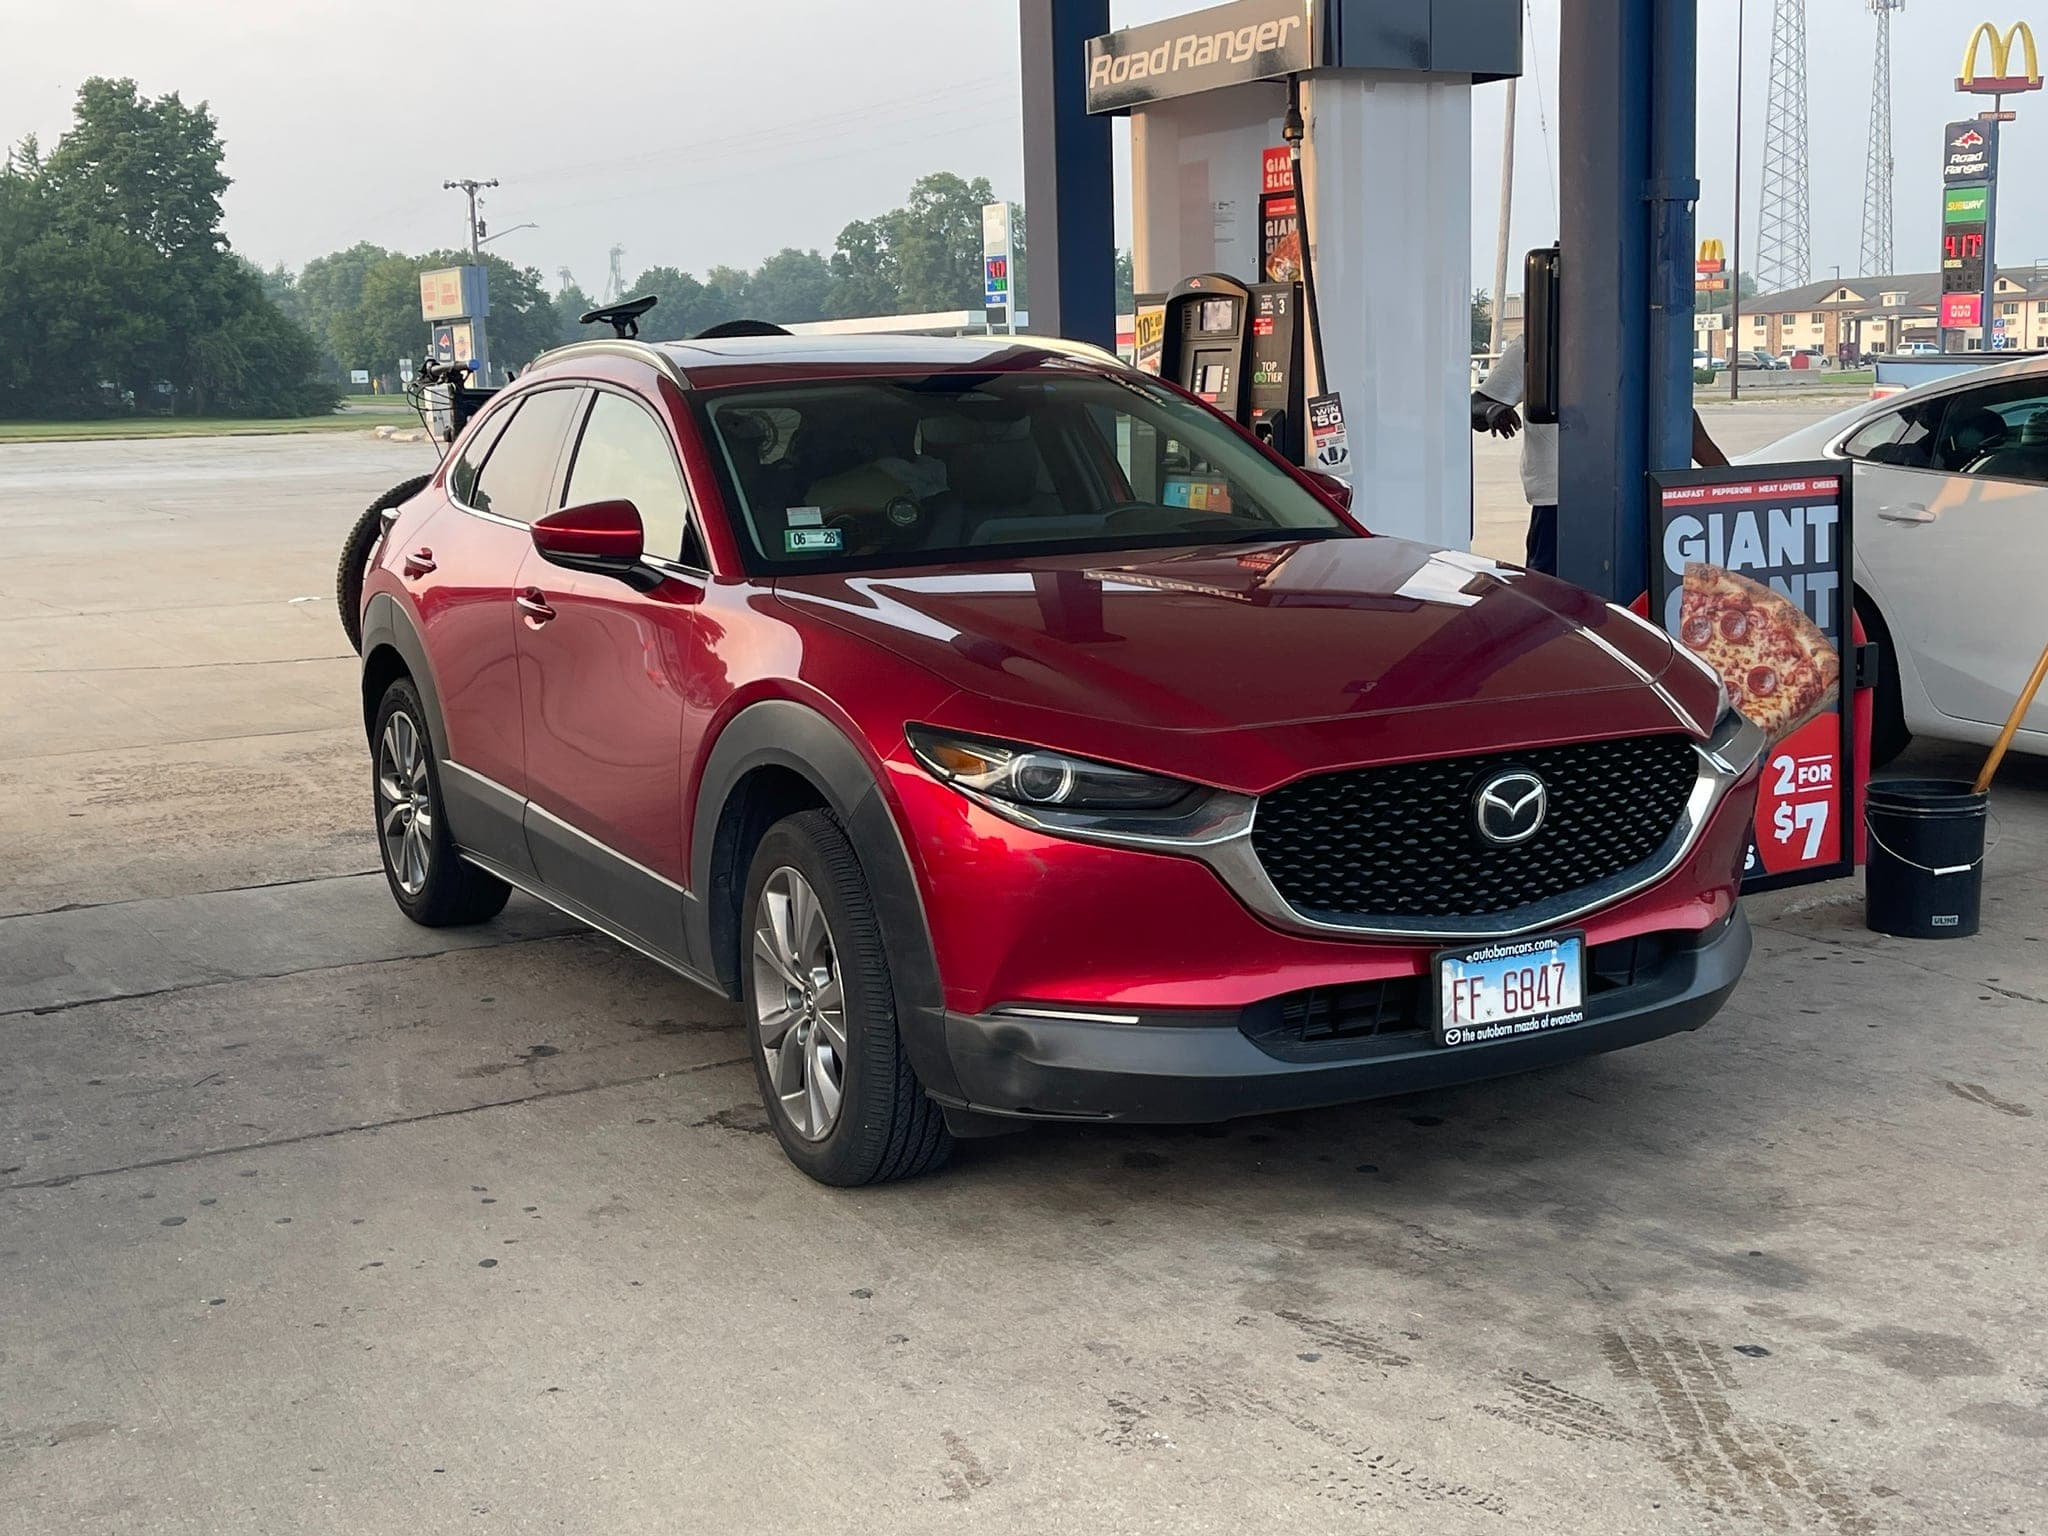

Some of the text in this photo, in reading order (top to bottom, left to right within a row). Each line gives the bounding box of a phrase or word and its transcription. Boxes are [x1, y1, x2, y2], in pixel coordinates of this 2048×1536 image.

[1089, 15, 1301, 89] Road Ranger
[1266, 157, 1292, 173] GIA
[1950, 152, 1983, 164] Road
[1944, 163, 1988, 175] Ranger
[1947, 199, 1984, 211] SUBWAY
[1265, 218, 1297, 237] GIAN
[1279, 299, 1285, 314] 3
[1261, 361, 1277, 372] TOP
[1267, 371, 1283, 383] TIER
[1315, 406, 1338, 416] WIN
[1662, 479, 1839, 500] BREAKFAST PEPPERONI MEAT LOVERS CHEESE
[793, 532, 806, 545] 06
[1663, 505, 1839, 576] GIANT
[1772, 755, 1832, 796] 2 FOR
[1774, 800, 1829, 861] $7
[1453, 962, 1566, 1023] FF 6847
[1462, 1012, 1583, 1042] the autobarn mazda of evanston
